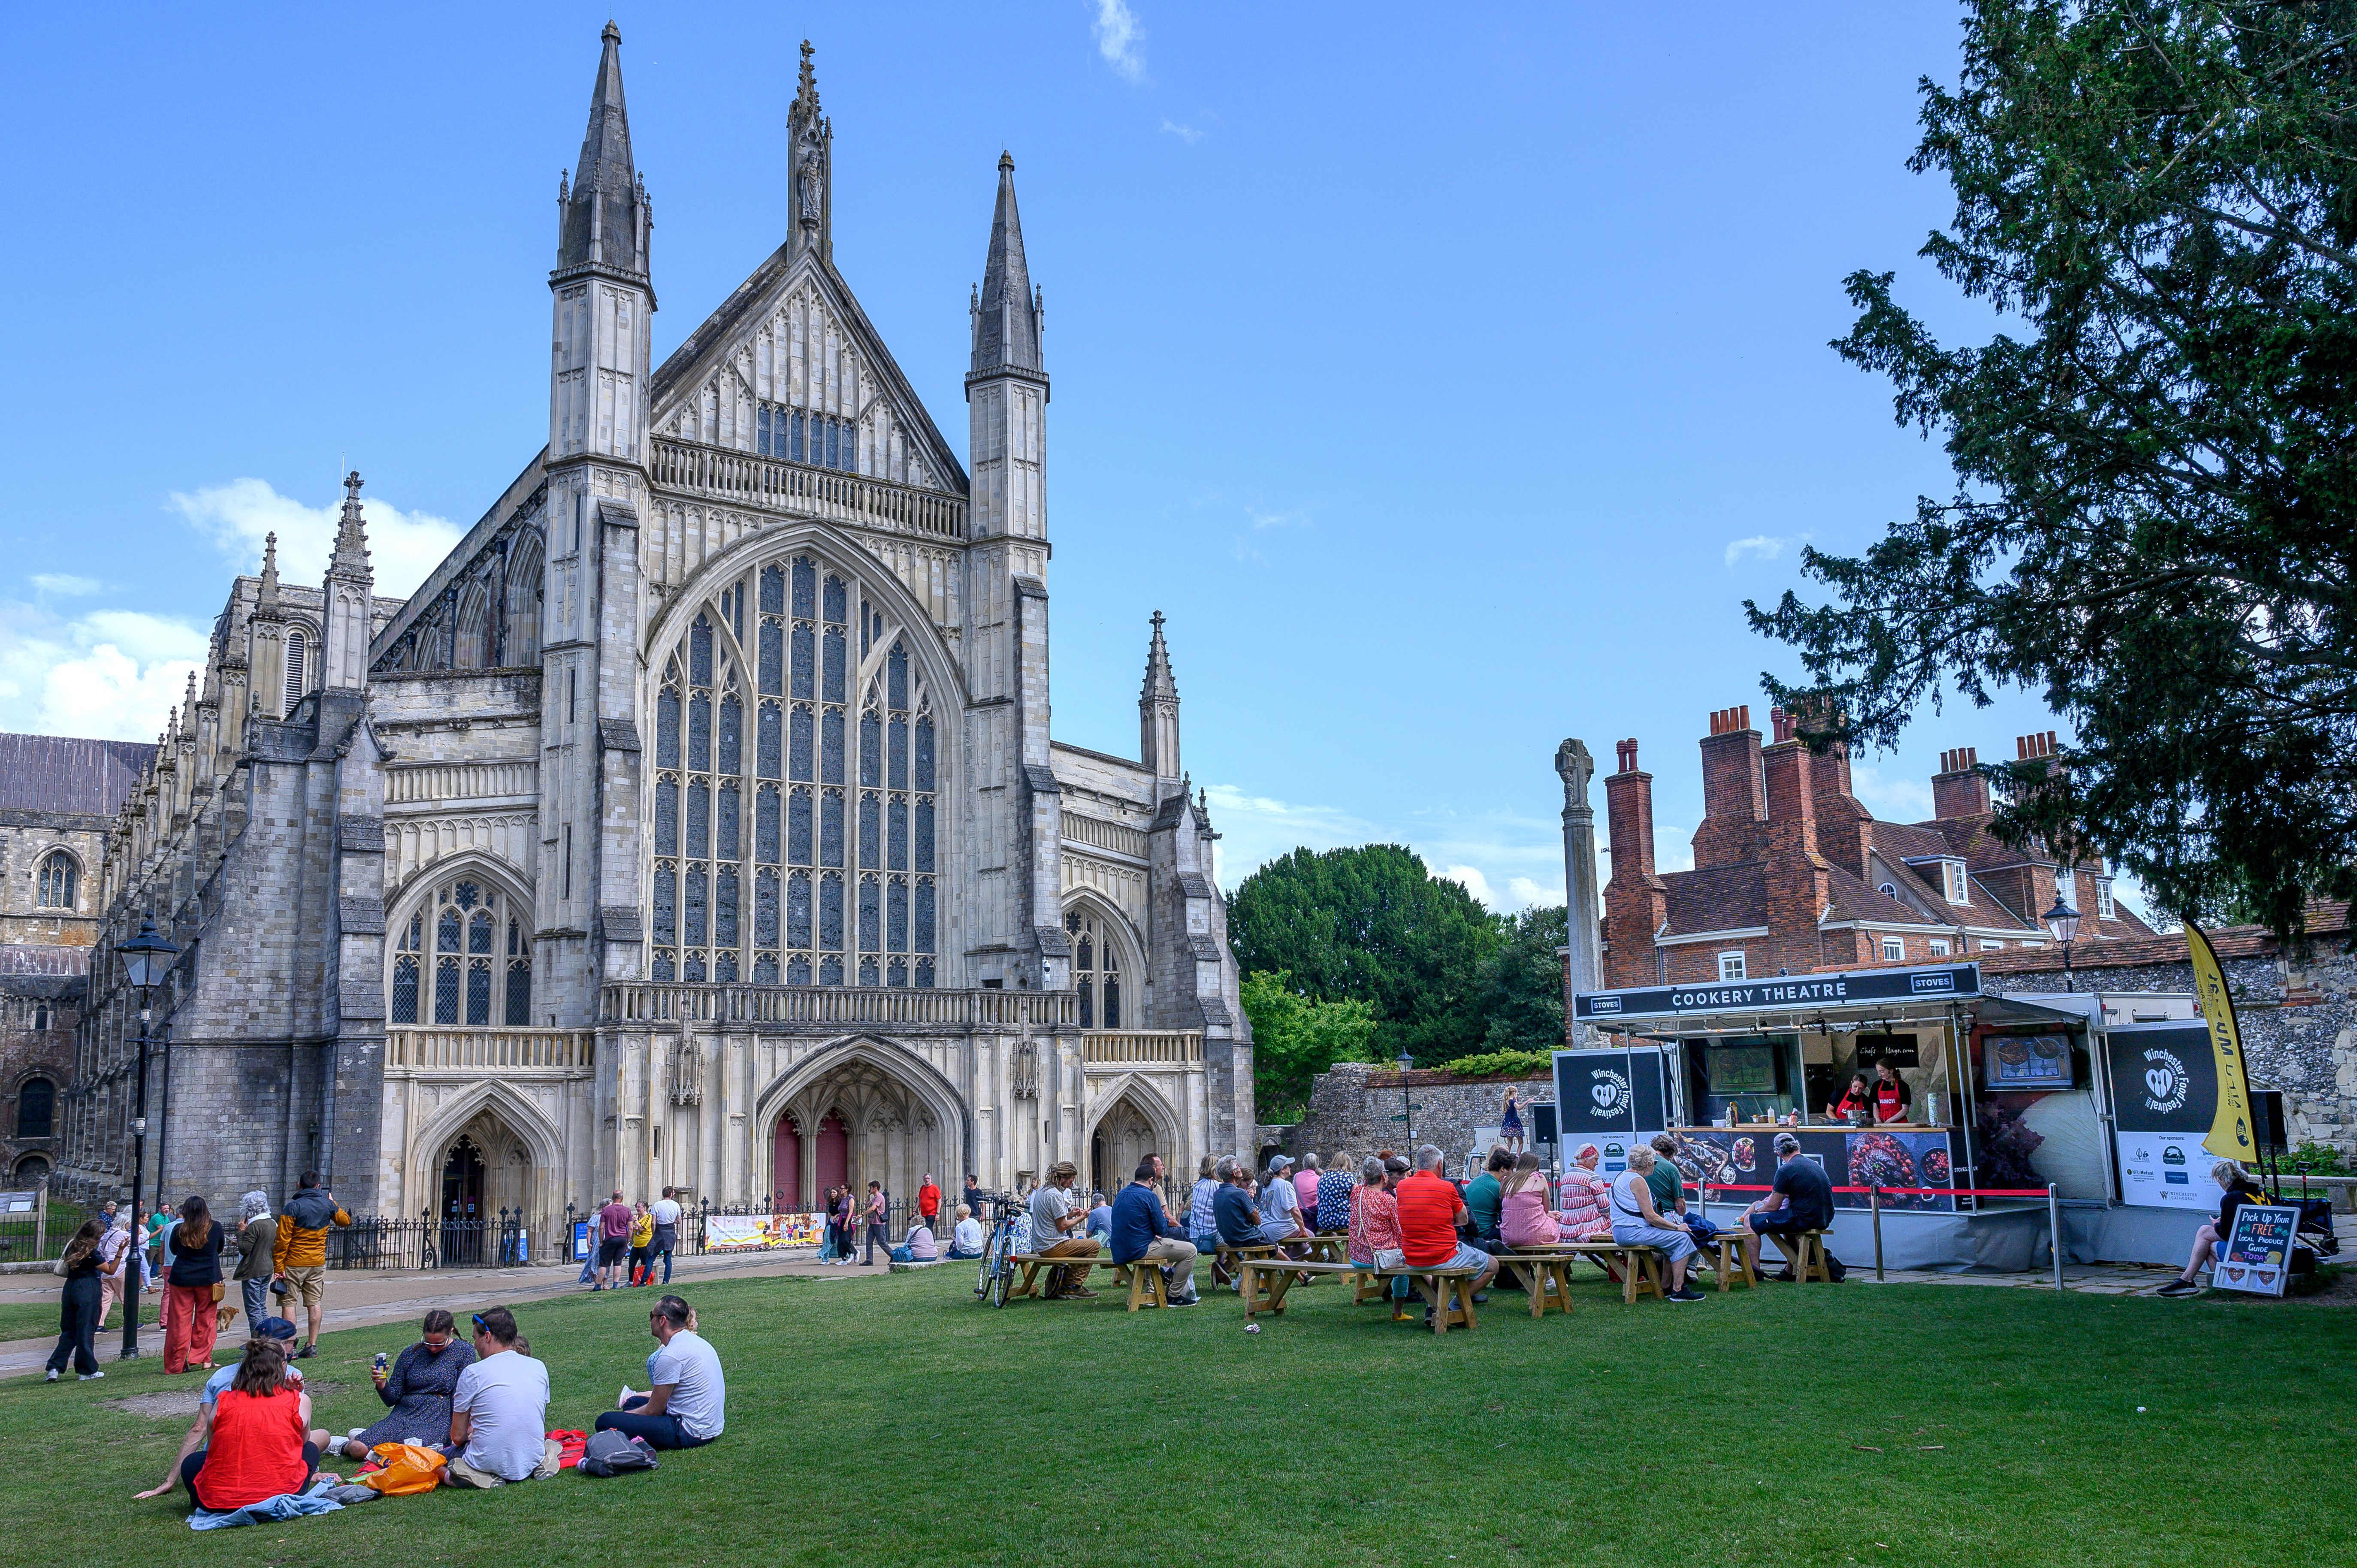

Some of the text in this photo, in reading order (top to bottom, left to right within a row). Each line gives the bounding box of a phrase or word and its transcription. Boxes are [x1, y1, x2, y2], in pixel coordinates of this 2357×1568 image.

[1915, 978, 1949, 987] STOVES
[1673, 982, 1846, 1006] COOKERY THEATRE
[1860, 1046, 1914, 1056] Chefs Stage.com
[2164, 1061, 2176, 1076] Sunday
[1591, 1069, 1629, 1089] Winchester
[1610, 1079, 1620, 1090] Sunday
[2143, 1048, 2189, 1115] Winchester Food Festival
[1620, 1091, 1631, 1109] Food
[1594, 1105, 1624, 1119] Festival
[2261, 1213, 2272, 1225] Up
[2251, 1224, 2275, 1236] FREE
[2238, 1234, 2284, 1245] LOCAL PRODUCE
[2248, 1243, 2269, 1252] GUIDE
[2242, 1251, 2271, 1262] TODAY
